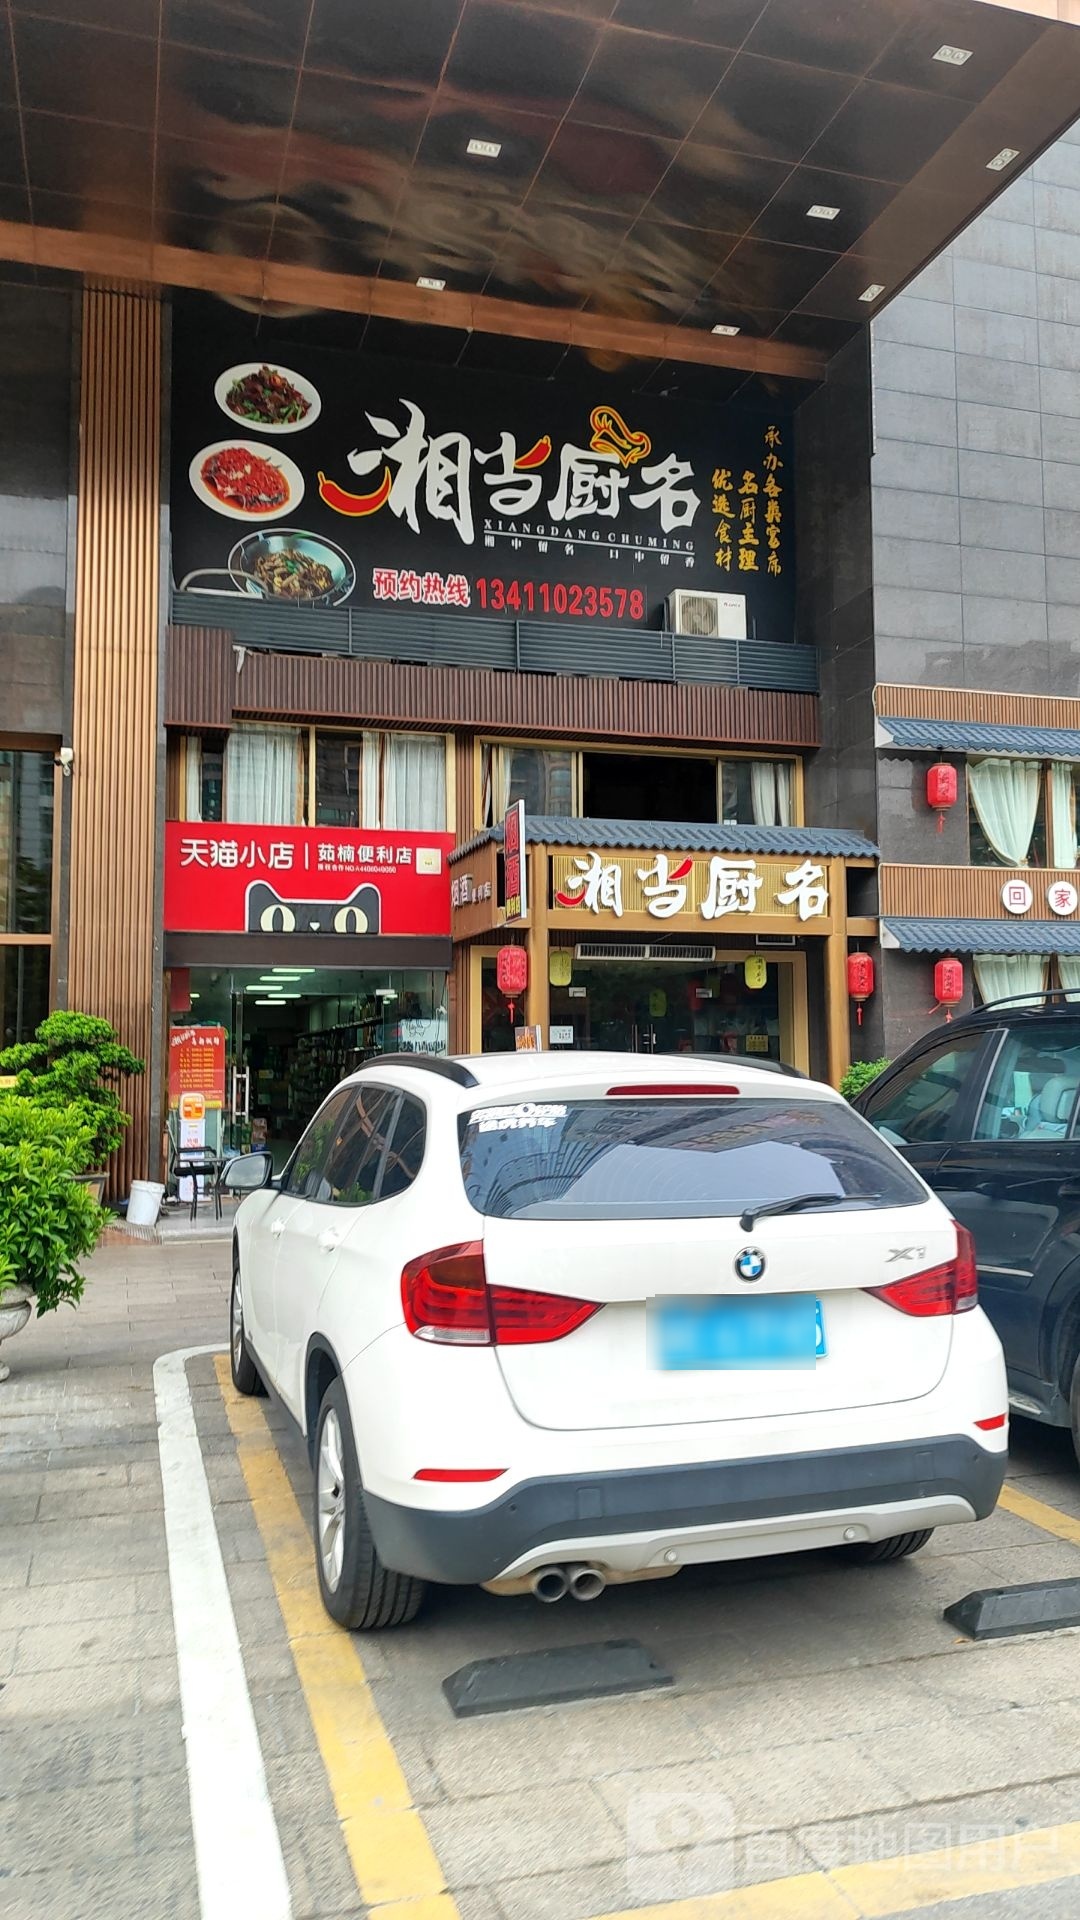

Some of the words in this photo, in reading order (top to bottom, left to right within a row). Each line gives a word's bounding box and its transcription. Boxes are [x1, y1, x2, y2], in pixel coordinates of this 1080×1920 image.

[318, 398, 701, 545] 湘当厨名
[484, 518, 600, 541] XIANGDANG
[607, 531, 695, 551] CHUMING
[711, 468, 736, 572] 优选食材
[738, 470, 760, 571] 名厨主理
[373, 568, 471, 608] 预约热线
[476, 577, 644, 620] 13411023578
[180, 838, 295, 870] 天猫小店
[317, 843, 413, 865] 茹楠便利店
[554, 850, 829, 922] 湘当厨名
[1008, 886, 1072, 908] 回家
